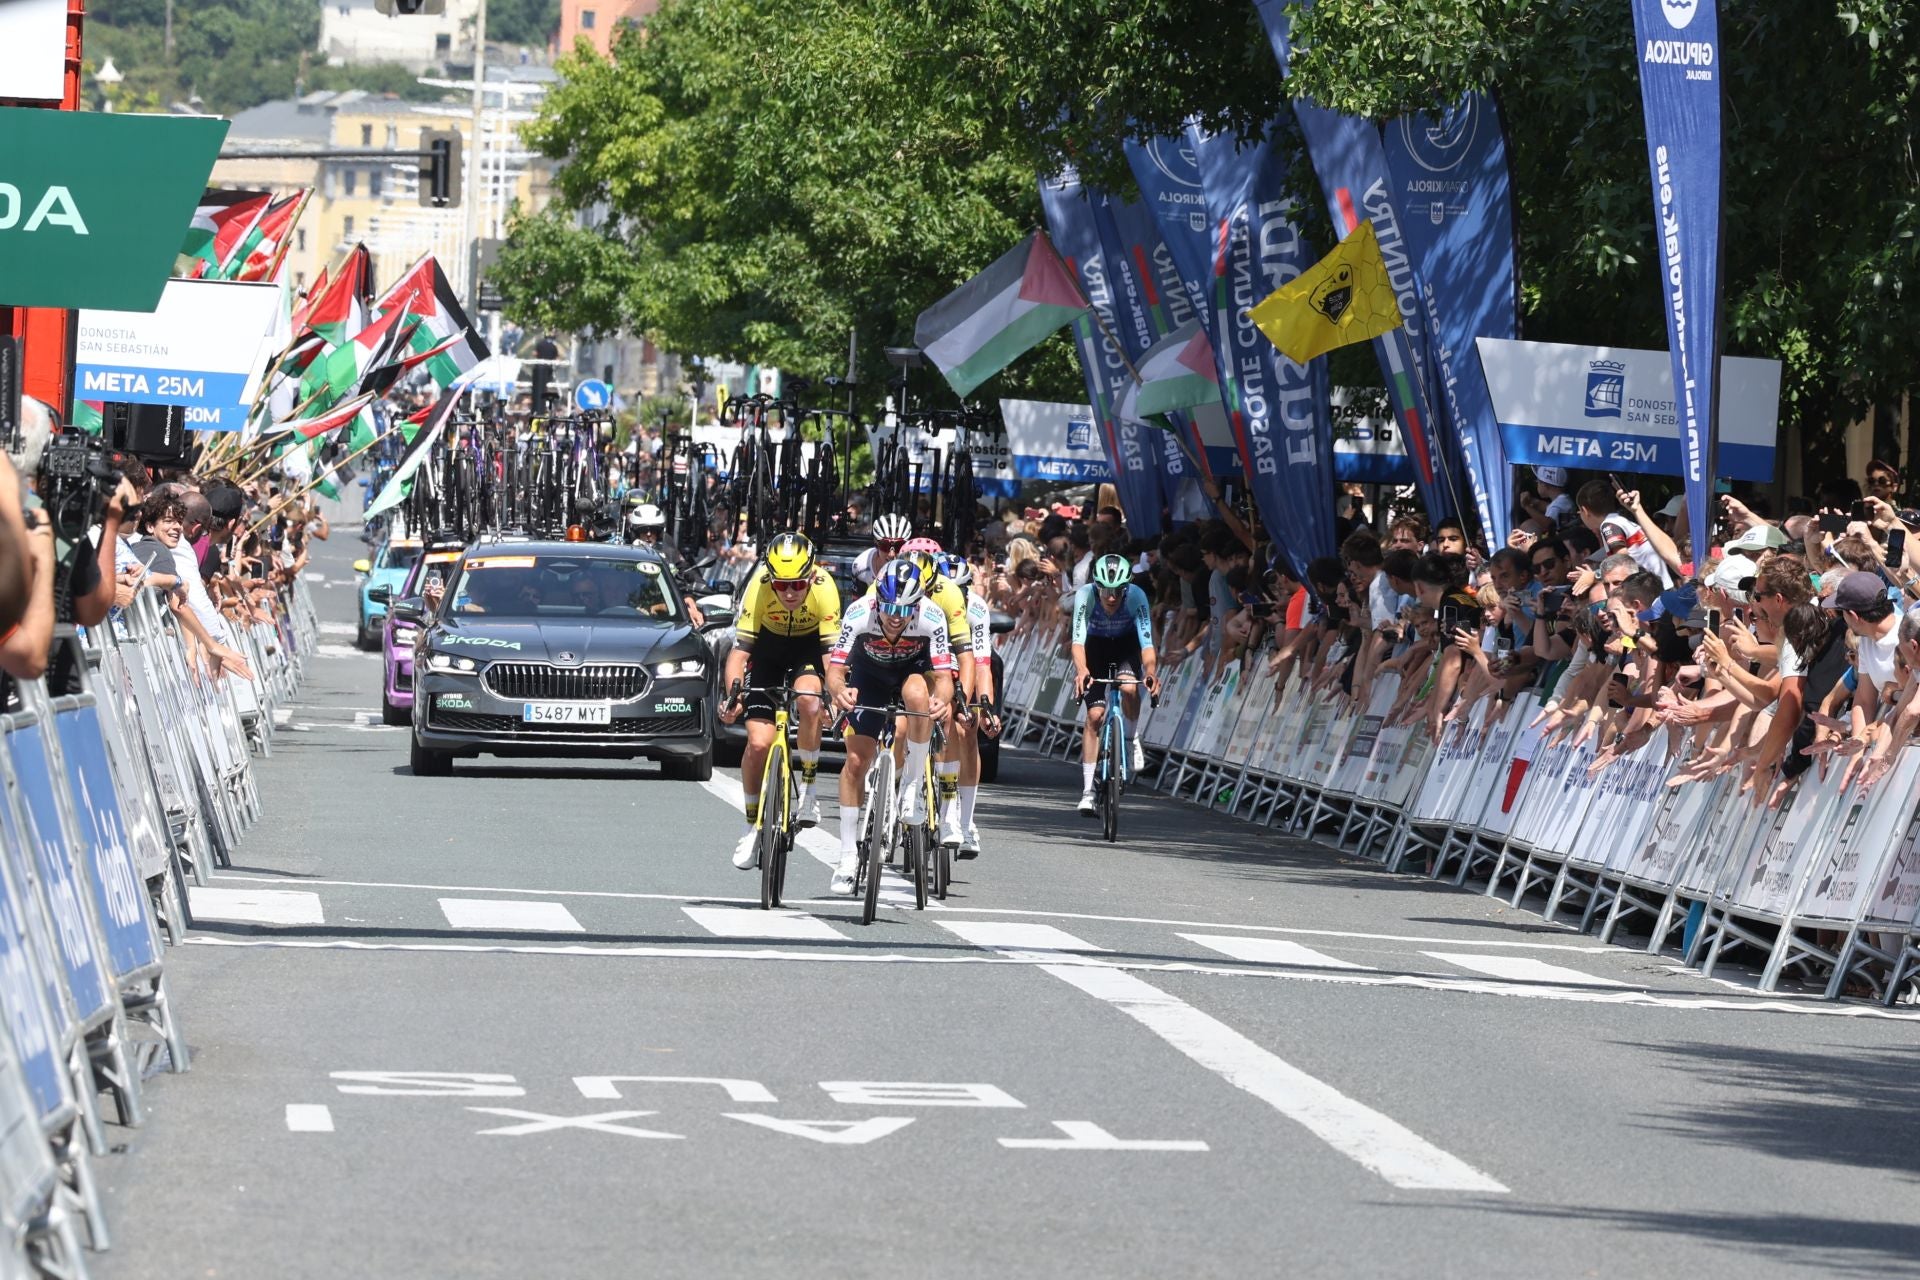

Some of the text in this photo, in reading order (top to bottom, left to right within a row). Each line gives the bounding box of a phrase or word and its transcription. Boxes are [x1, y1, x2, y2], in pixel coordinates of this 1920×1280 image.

[80, 327, 137, 340] DONOSTIA
[80, 341, 169, 356] SAN SEBASTIÁN
[84, 371, 204, 397] META 25M
[1627, 412, 1650, 423] SAN
[1628, 398, 1677, 412] DONOSTI
[1537, 433, 1658, 463] META 25M
[1038, 461, 1112, 478] META 75M
[837, 624, 854, 649] BOSS
[933, 626, 946, 655] BOSS
[974, 624, 984, 651] BOSS
[535, 706, 606, 721] 5487 MYT
[329, 1070, 1027, 1108] BUS
[284, 1103, 1211, 1151] TAXI
